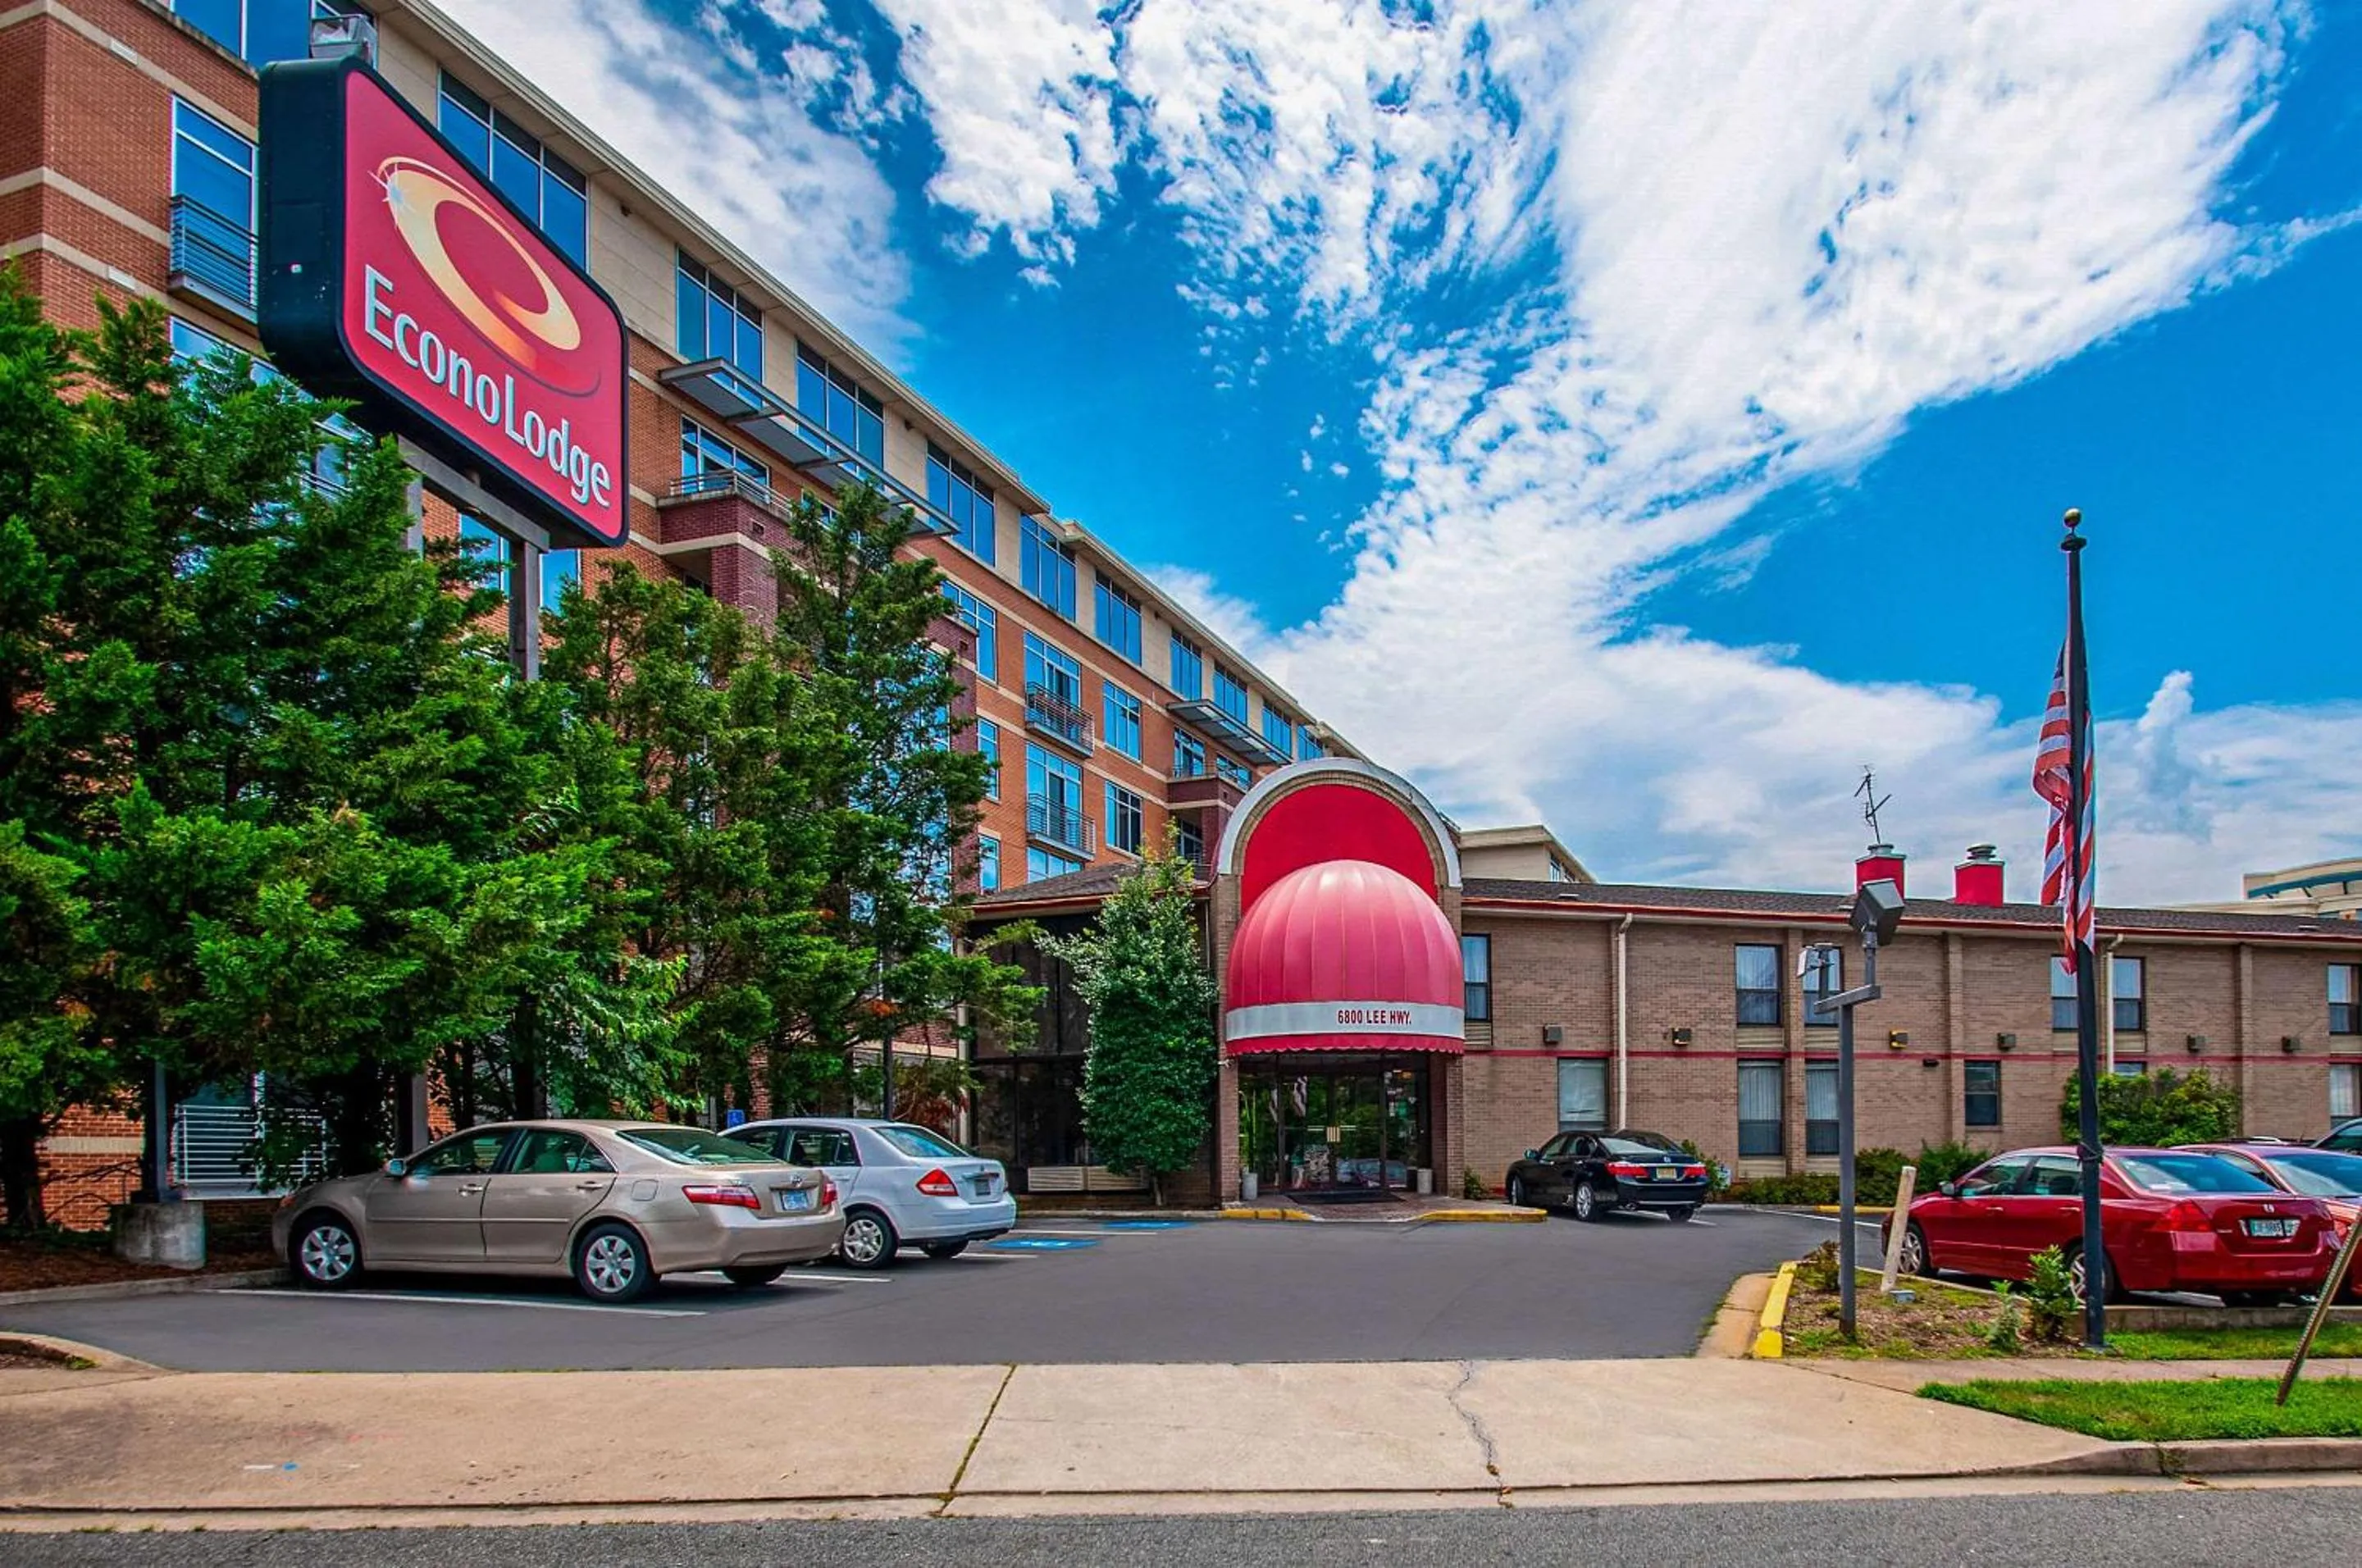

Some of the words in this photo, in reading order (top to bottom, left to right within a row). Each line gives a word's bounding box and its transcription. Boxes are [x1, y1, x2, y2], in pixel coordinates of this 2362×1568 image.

[1338, 1010, 1362, 1024] 6800
[1366, 1010, 1386, 1024] LEE
[1389, 1010, 1411, 1025] HWY.
